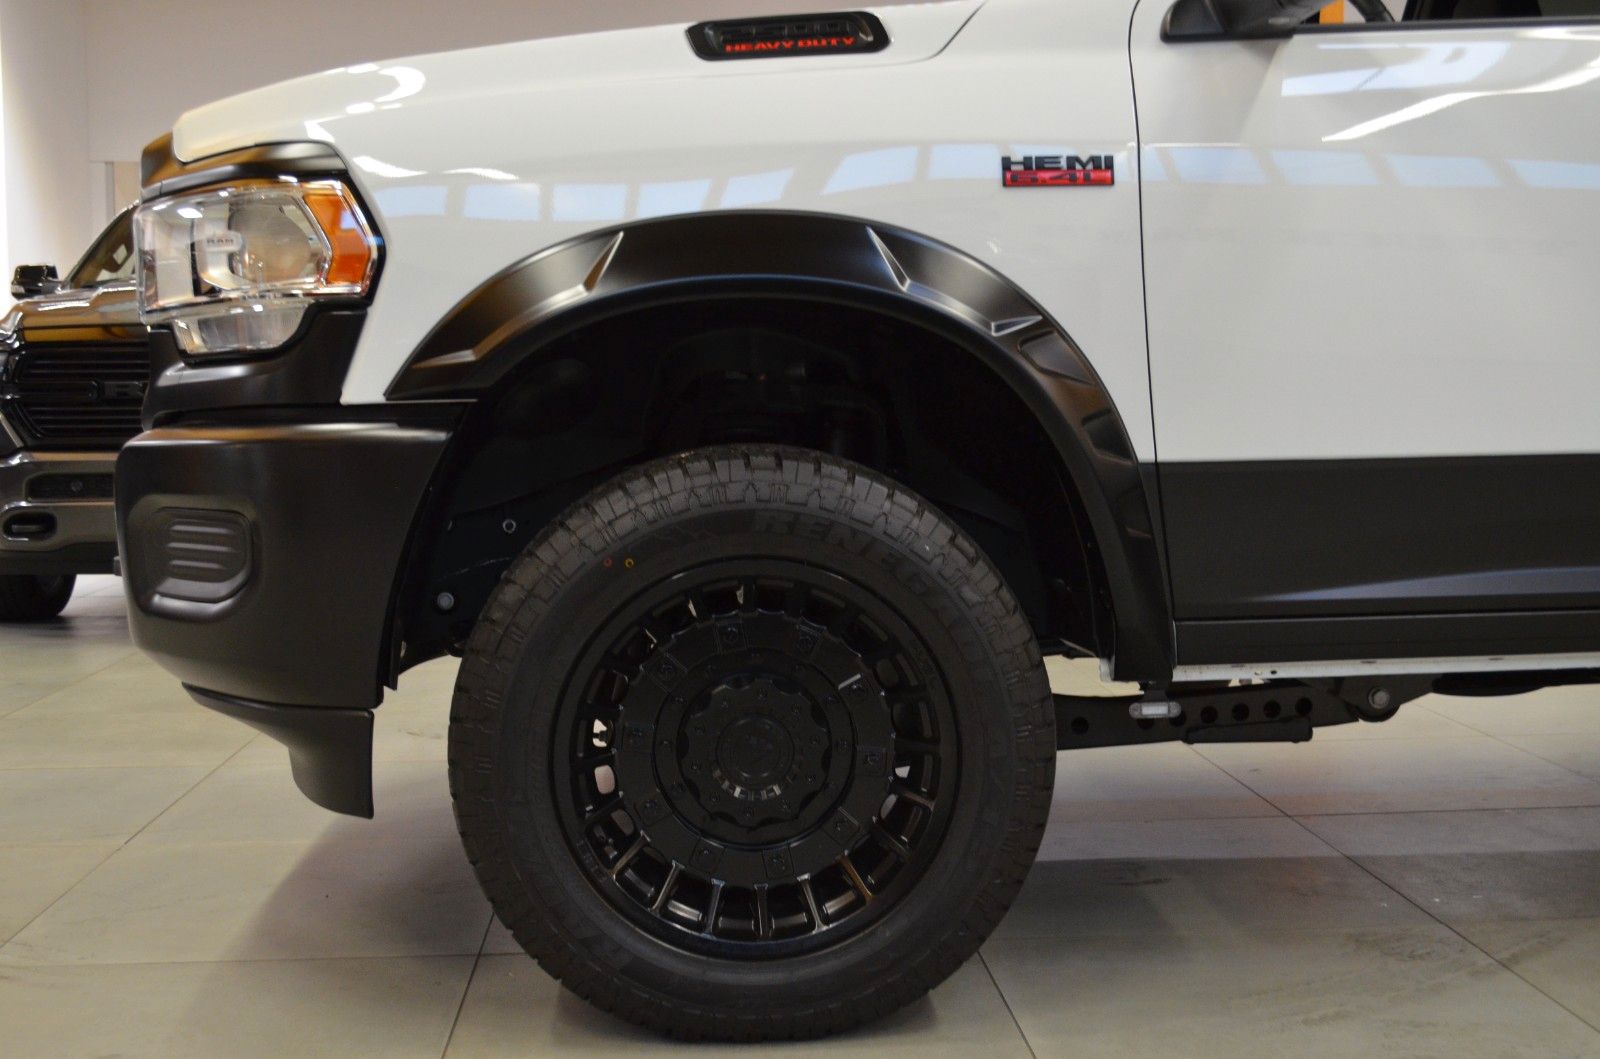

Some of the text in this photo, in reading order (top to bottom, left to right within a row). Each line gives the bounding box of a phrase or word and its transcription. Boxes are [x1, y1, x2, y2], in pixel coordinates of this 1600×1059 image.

[725, 36, 856, 52] HEAVY DUTY
[1001, 155, 1114, 171] HEMI
[206, 237, 235, 246] RAM
